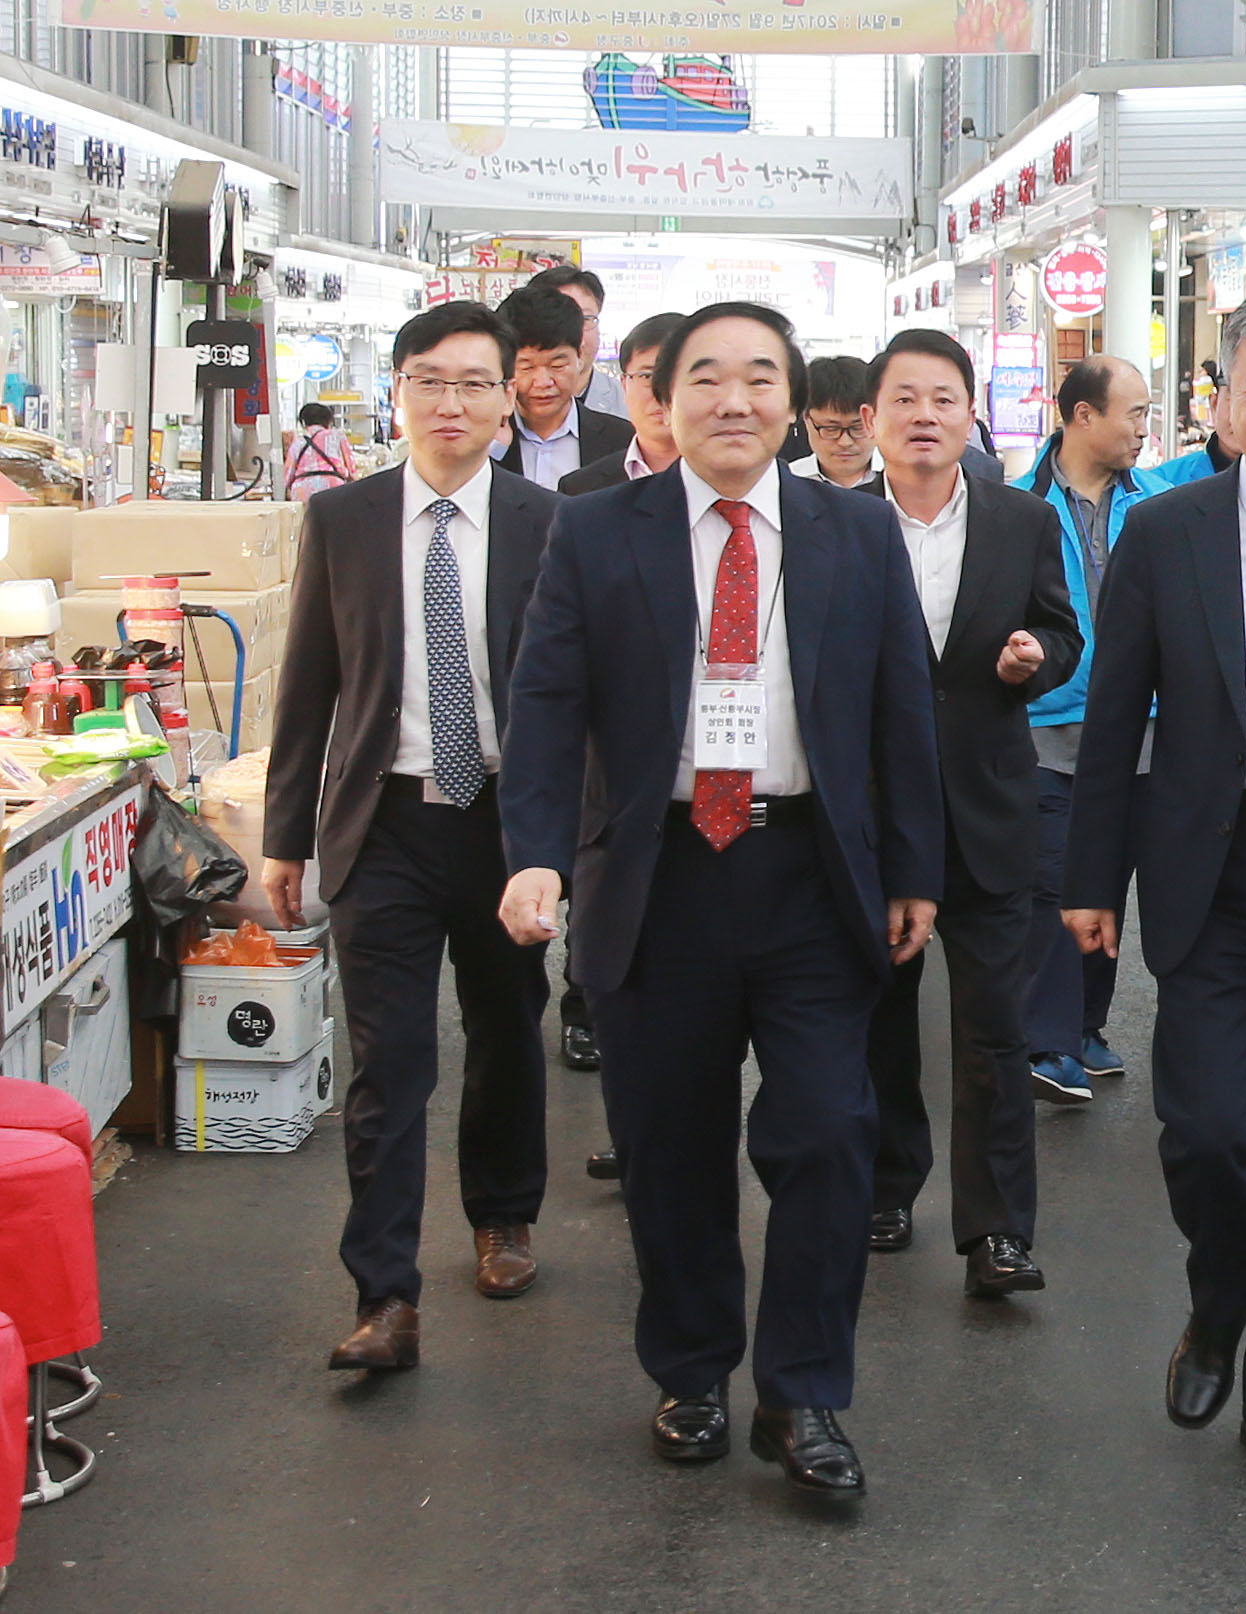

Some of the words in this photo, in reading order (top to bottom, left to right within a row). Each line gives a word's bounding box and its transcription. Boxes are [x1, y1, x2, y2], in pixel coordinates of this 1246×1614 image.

[194, 343, 251, 367] SOS
[85, 797, 139, 894] 직영매장
[235, 1010, 269, 1037] 명란
